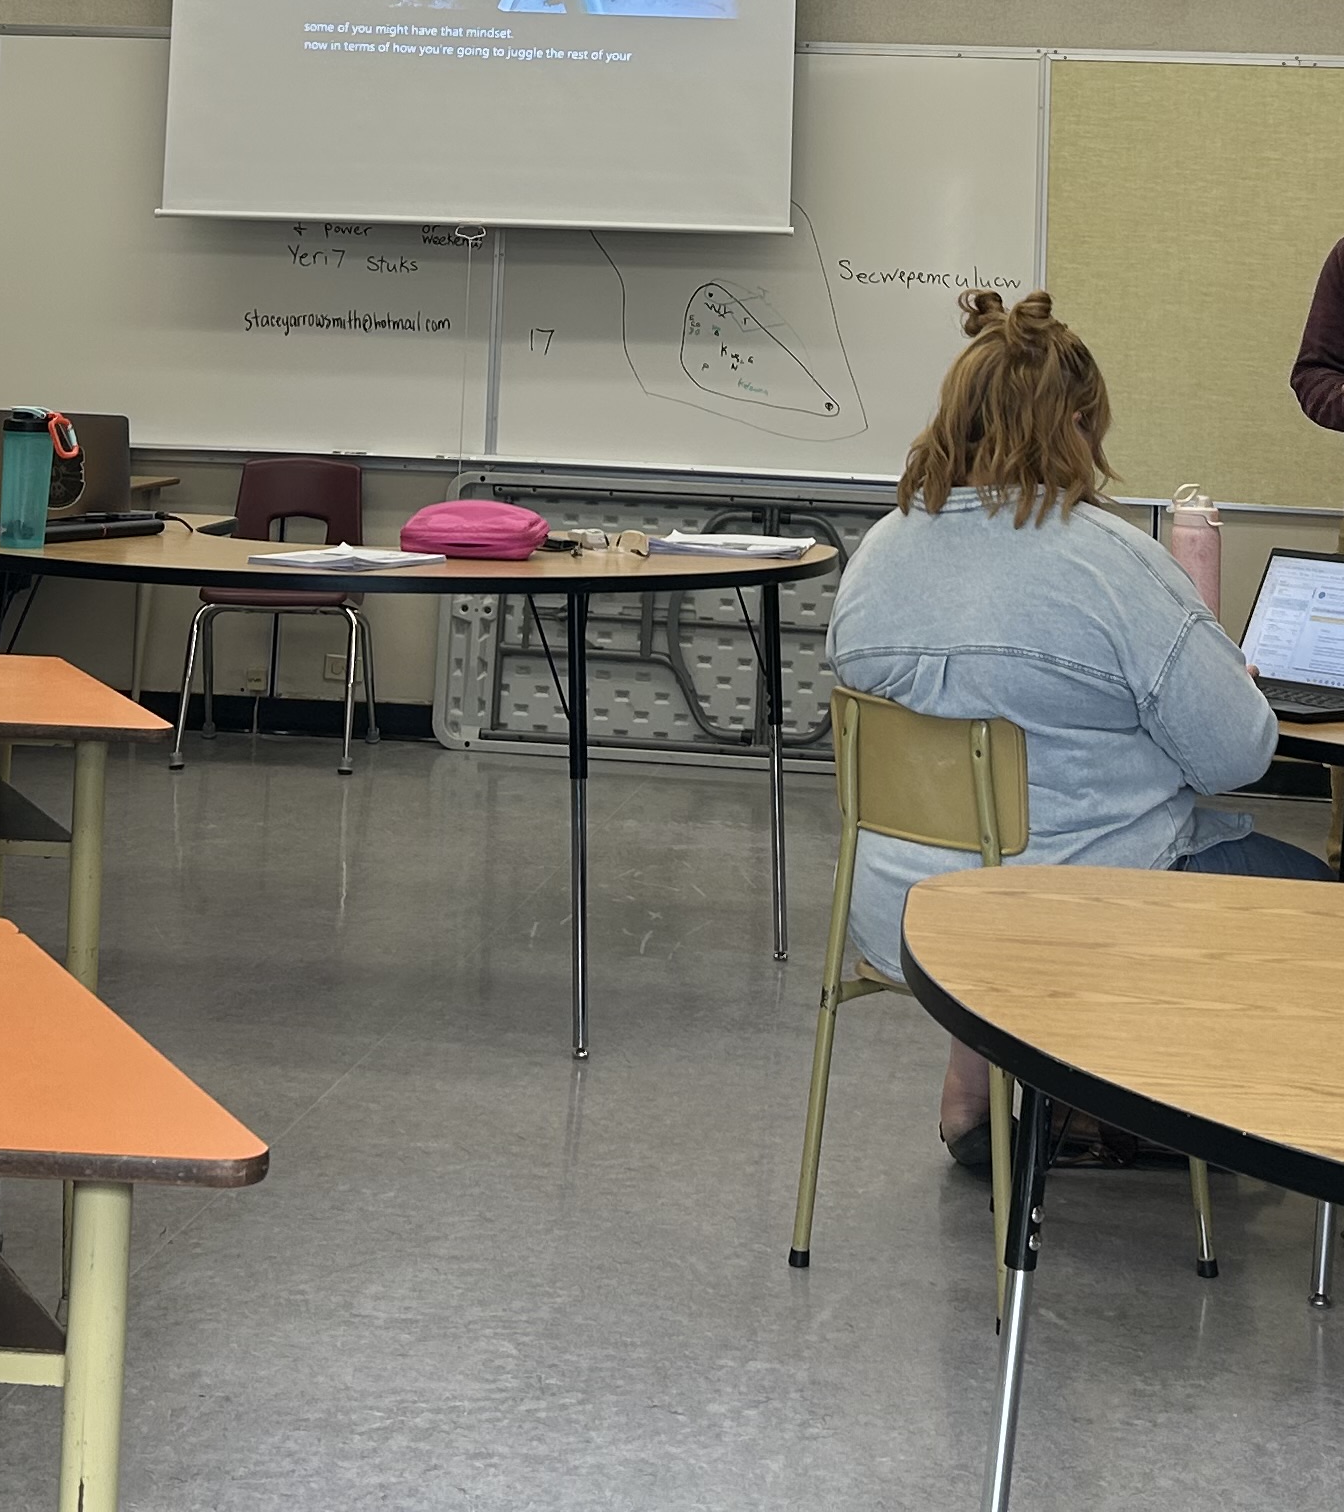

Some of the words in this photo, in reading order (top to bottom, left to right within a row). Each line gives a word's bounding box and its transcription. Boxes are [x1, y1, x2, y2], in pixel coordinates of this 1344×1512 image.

[304, 23, 335, 33] some
[337, 22, 350, 33] of
[351, 24, 373, 36] you
[375, 23, 409, 37] might
[411, 25, 438, 36] have
[440, 25, 464, 37] that
[304, 41, 328, 51] now
[330, 40, 341, 51] in
[343, 41, 375, 52] terms
[377, 42, 391, 53] of
[392, 42, 417, 54] how
[418, 44, 454, 57] you're
[456, 46, 490, 59] going
[492, 46, 505, 57] to
[505, 46, 543, 60] juggle
[545, 48, 565, 59] the
[567, 49, 589, 60] rest
[590, 49, 604, 61] of
[605, 51, 633, 64] your
[530, 328, 555, 356] 17
